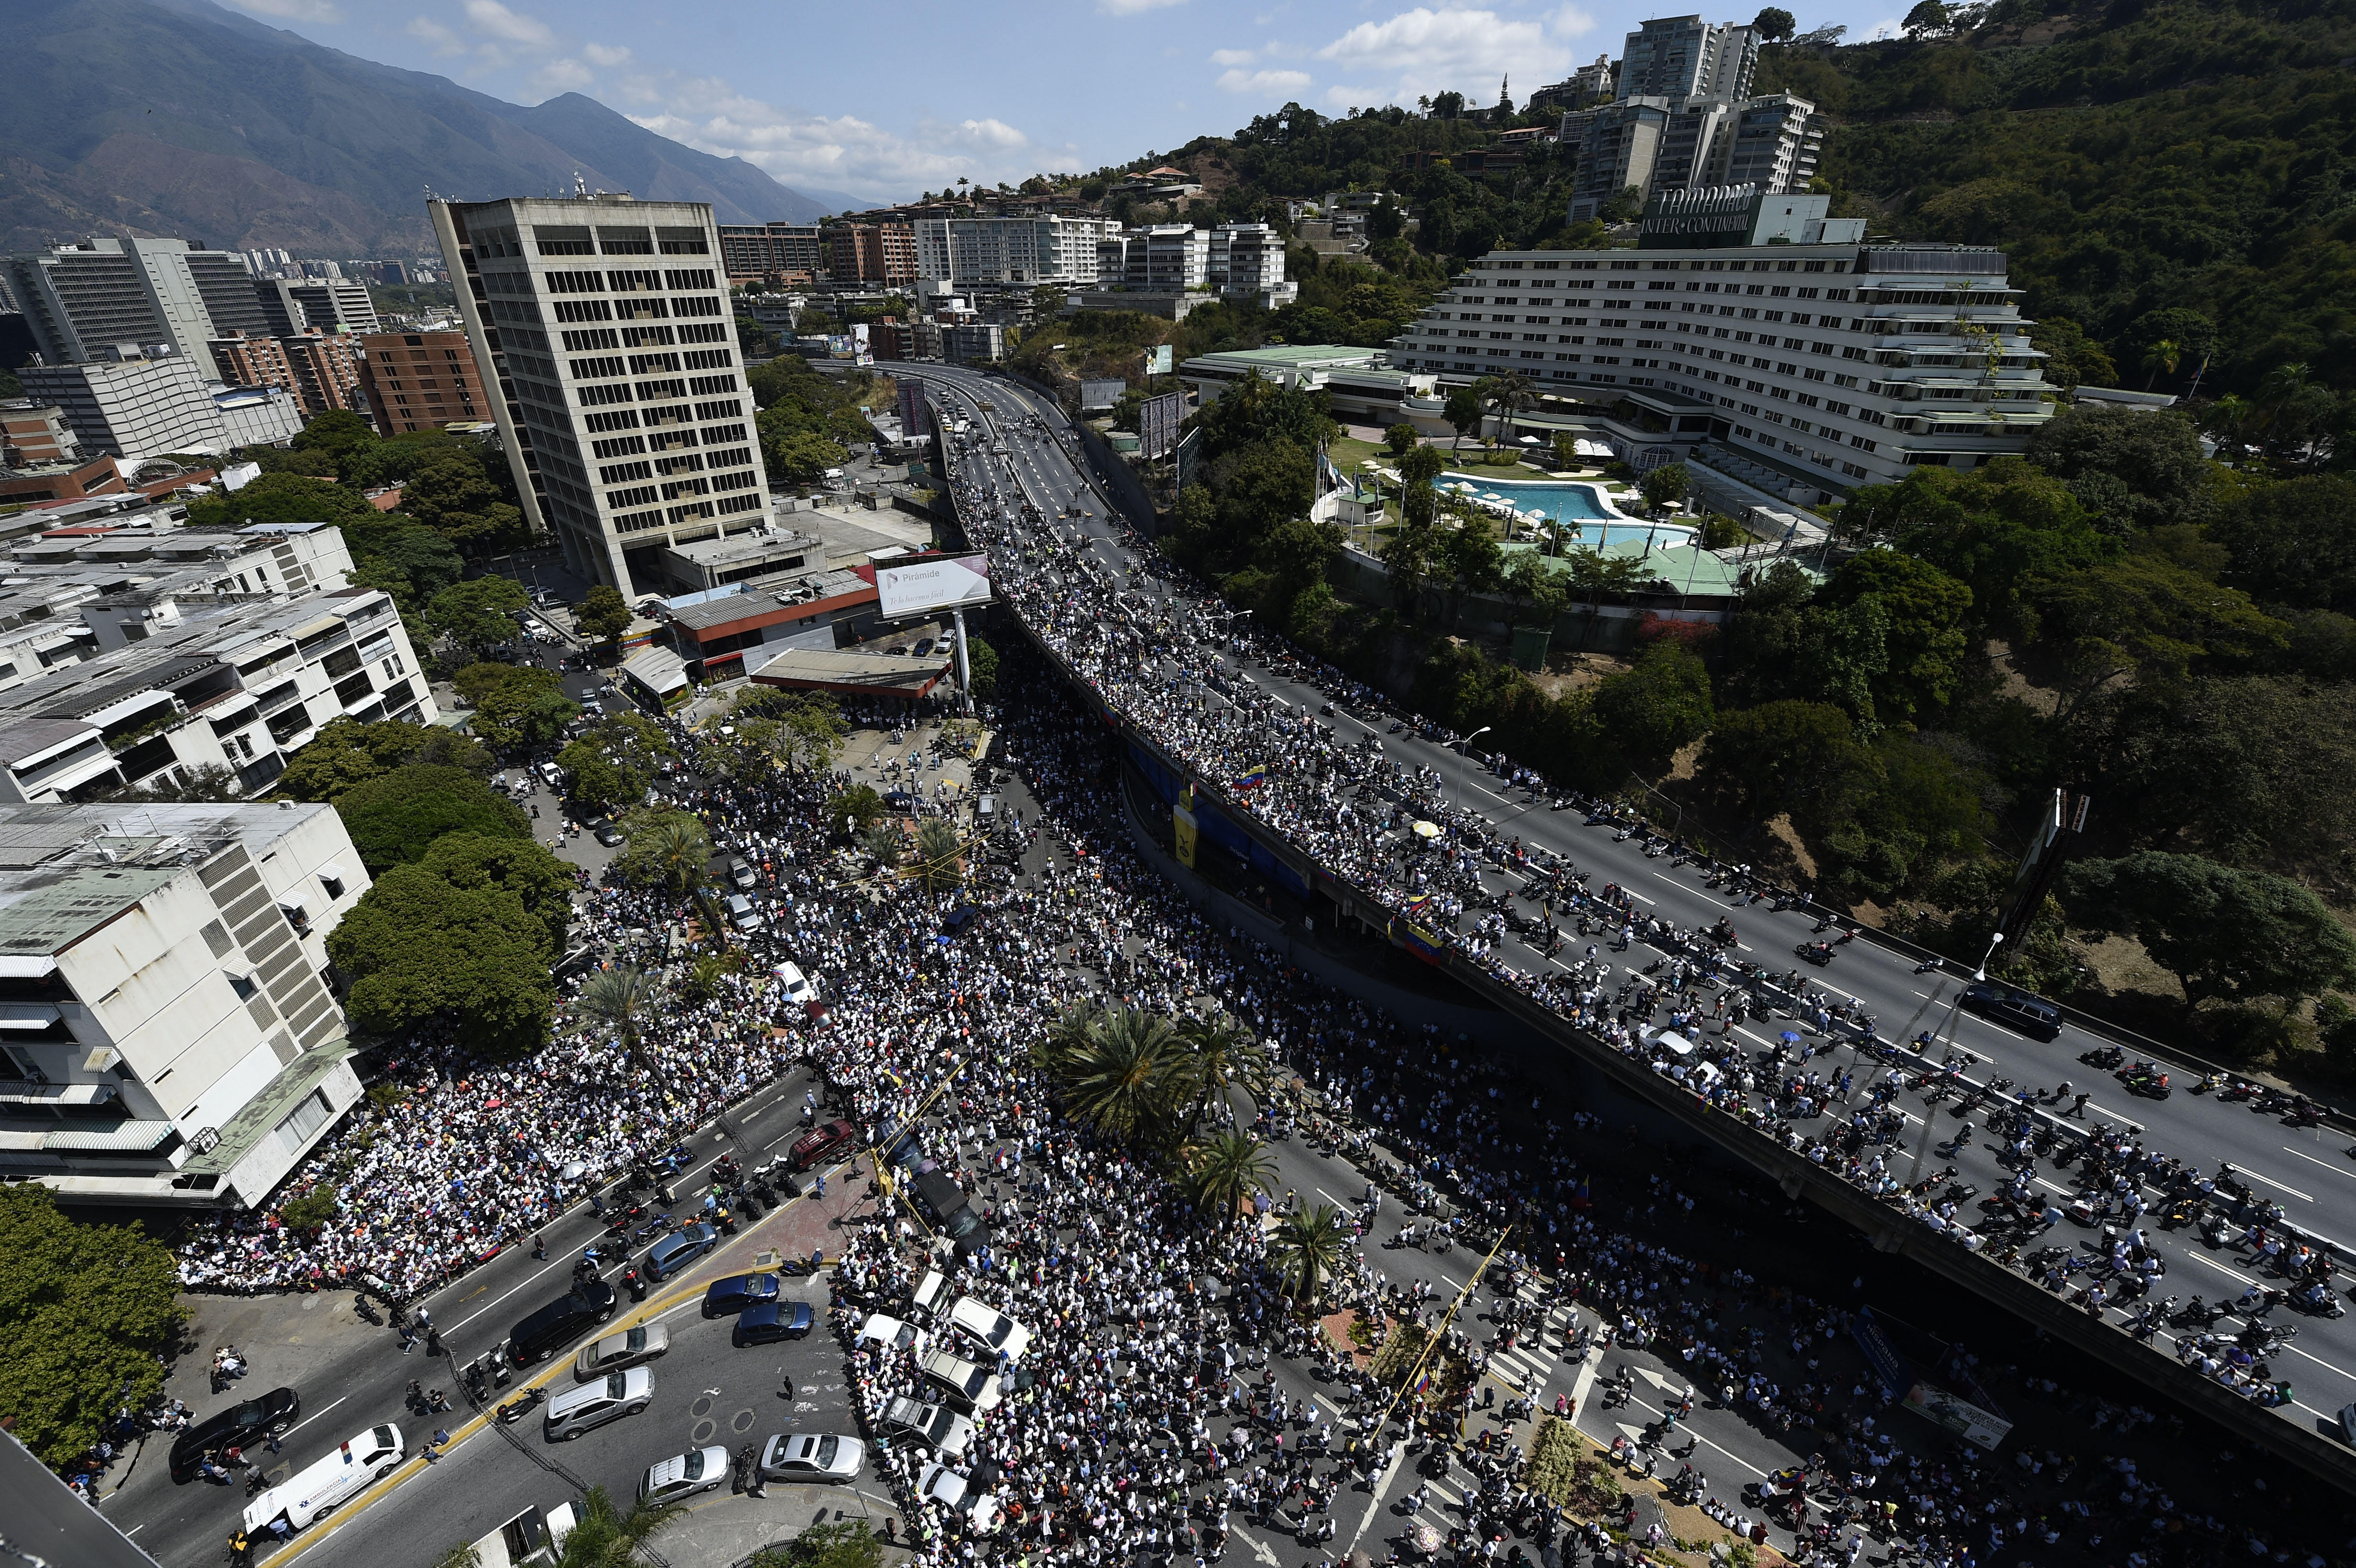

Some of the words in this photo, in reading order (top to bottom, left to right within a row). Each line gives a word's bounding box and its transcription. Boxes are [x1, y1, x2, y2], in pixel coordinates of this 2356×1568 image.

[1658, 182, 1756, 215] TAMANACO
[1641, 218, 1680, 235] INTER
[1687, 214, 1749, 233] CONTINENTAL
[903, 569, 940, 582] Pirámide
[905, 594, 929, 602] hacemos
[930, 589, 944, 600] fácil
[1230, 845, 1249, 861] Original
[310, 1479, 342, 1502] AMBULANCIA
